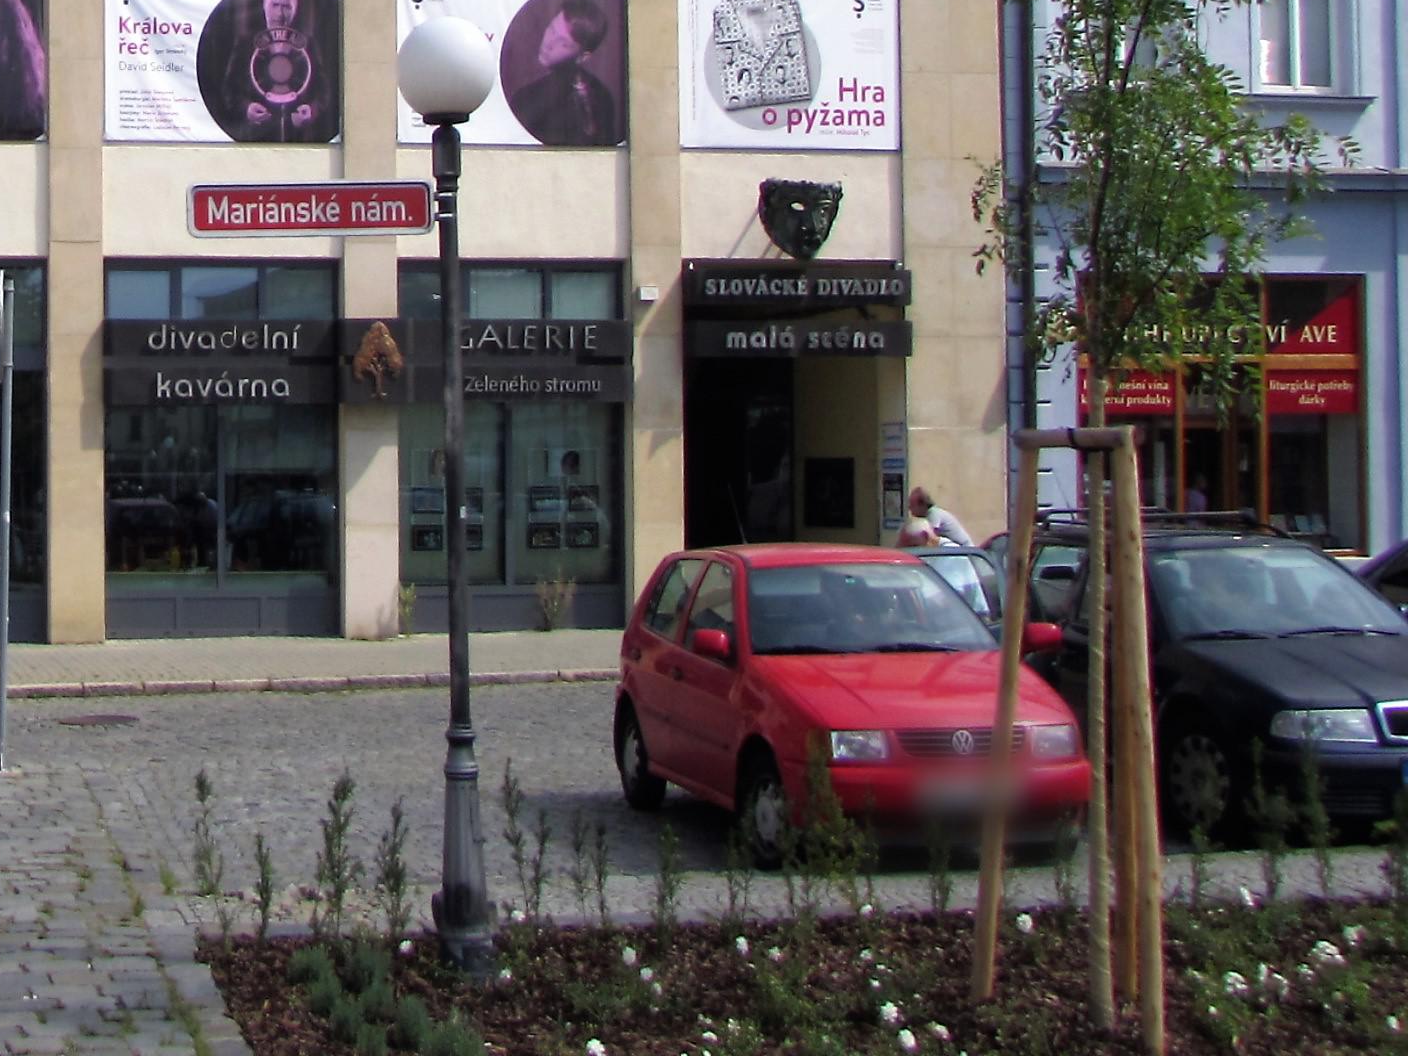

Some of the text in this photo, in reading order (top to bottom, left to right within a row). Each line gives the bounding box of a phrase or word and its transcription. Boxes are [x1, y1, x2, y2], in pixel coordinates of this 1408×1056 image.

[119, 16, 192, 35] Králova
[119, 37, 149, 55] řeč
[119, 61, 184, 72] David Seidler
[839, 77, 885, 102] Hra
[762, 102, 885, 134] o pyžama
[207, 193, 413, 224] Mariánské nám.
[705, 274, 904, 296] SLOVÁCKÉ DIVADLO
[148, 324, 302, 350] divadelní
[726, 325, 886, 349] malá scéna
[1300, 325, 1337, 342] AVE
[157, 370, 290, 398] kavárna
[464, 375, 602, 393] Zeleného stromu
[1126, 394, 1171, 407] produkty
[1299, 394, 1326, 407] dárky
